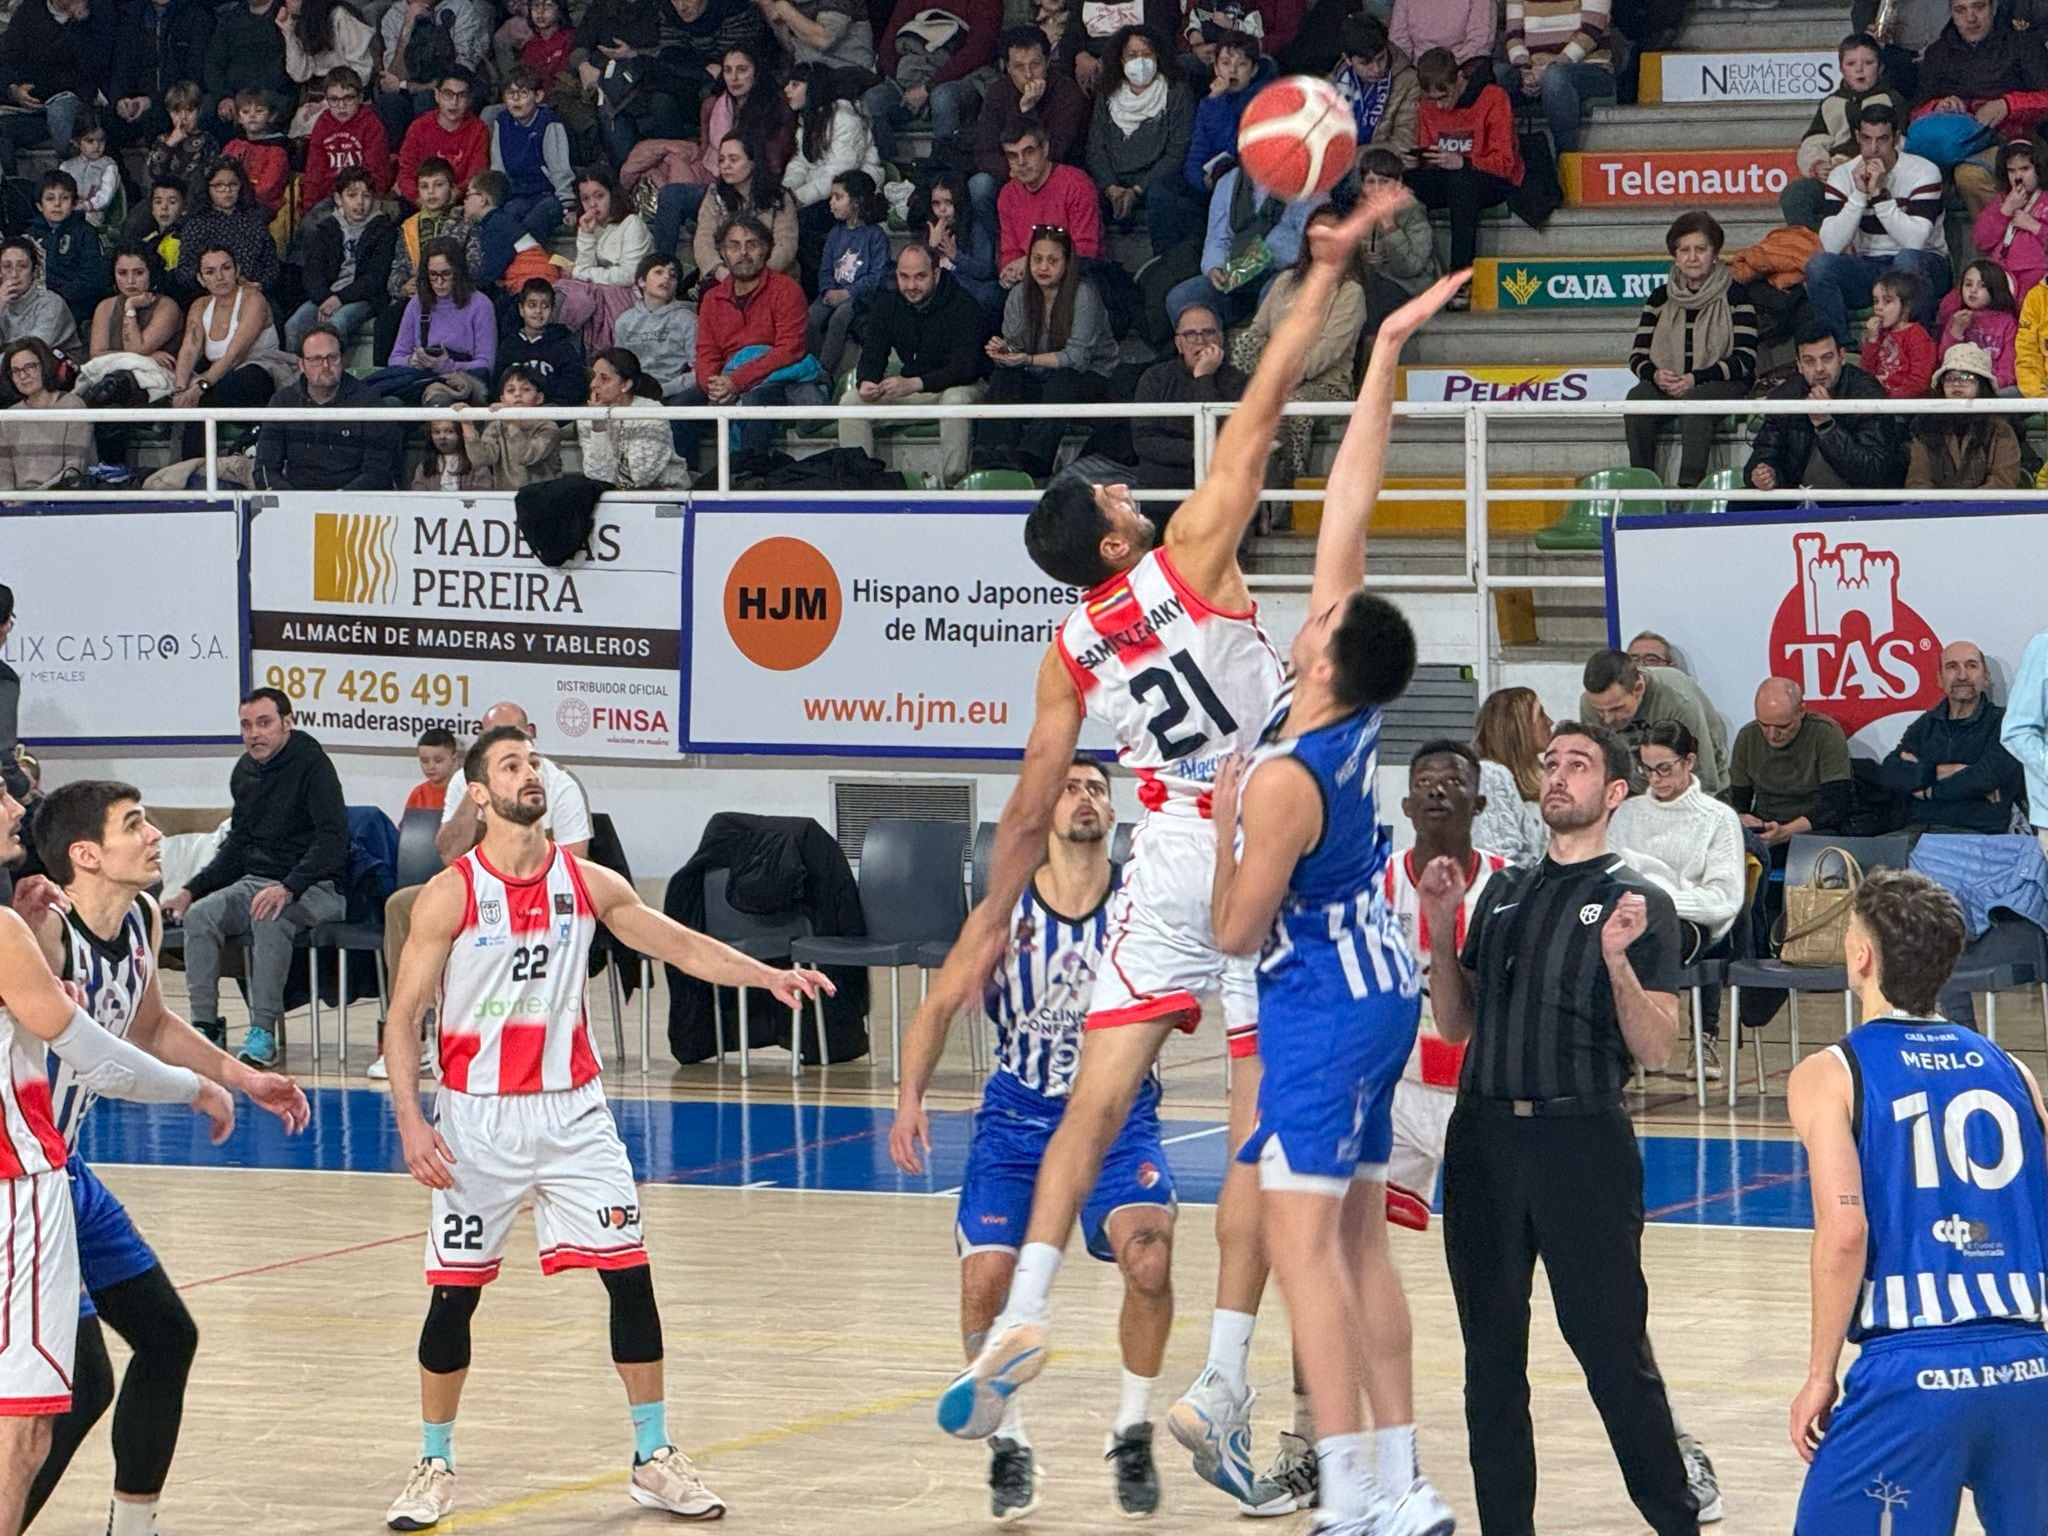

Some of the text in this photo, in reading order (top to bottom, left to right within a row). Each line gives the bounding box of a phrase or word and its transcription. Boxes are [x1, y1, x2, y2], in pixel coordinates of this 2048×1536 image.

[1600, 162, 1788, 195] Telenauto
[1547, 275, 1616, 300] CAJA
[413, 568, 583, 613] PEREIRA
[739, 587, 827, 620] HJM
[853, 579, 960, 608] Hispano
[190, 633, 229, 659] S.A.
[282, 622, 650, 657] ALMACÉN DE MADERAS Y TABLEROS
[885, 618, 1064, 647] de Maquinari
[31, 671, 86, 682] METALES
[266, 665, 470, 707] 987 426 491
[1784, 639, 1920, 701] TAS
[557, 680, 669, 696] DISTRIBUIDOR OFICIAL
[1129, 648, 1239, 761] 21
[593, 707, 669, 732] FINSA
[804, 693, 1008, 731] www.hjm.eu
[512, 944, 549, 982] 22
[1901, 1050, 1985, 1070] MERLO
[1893, 1089, 2025, 1190] 10
[444, 1214, 483, 1250] 22
[1917, 1367, 1979, 1391] CAJA
